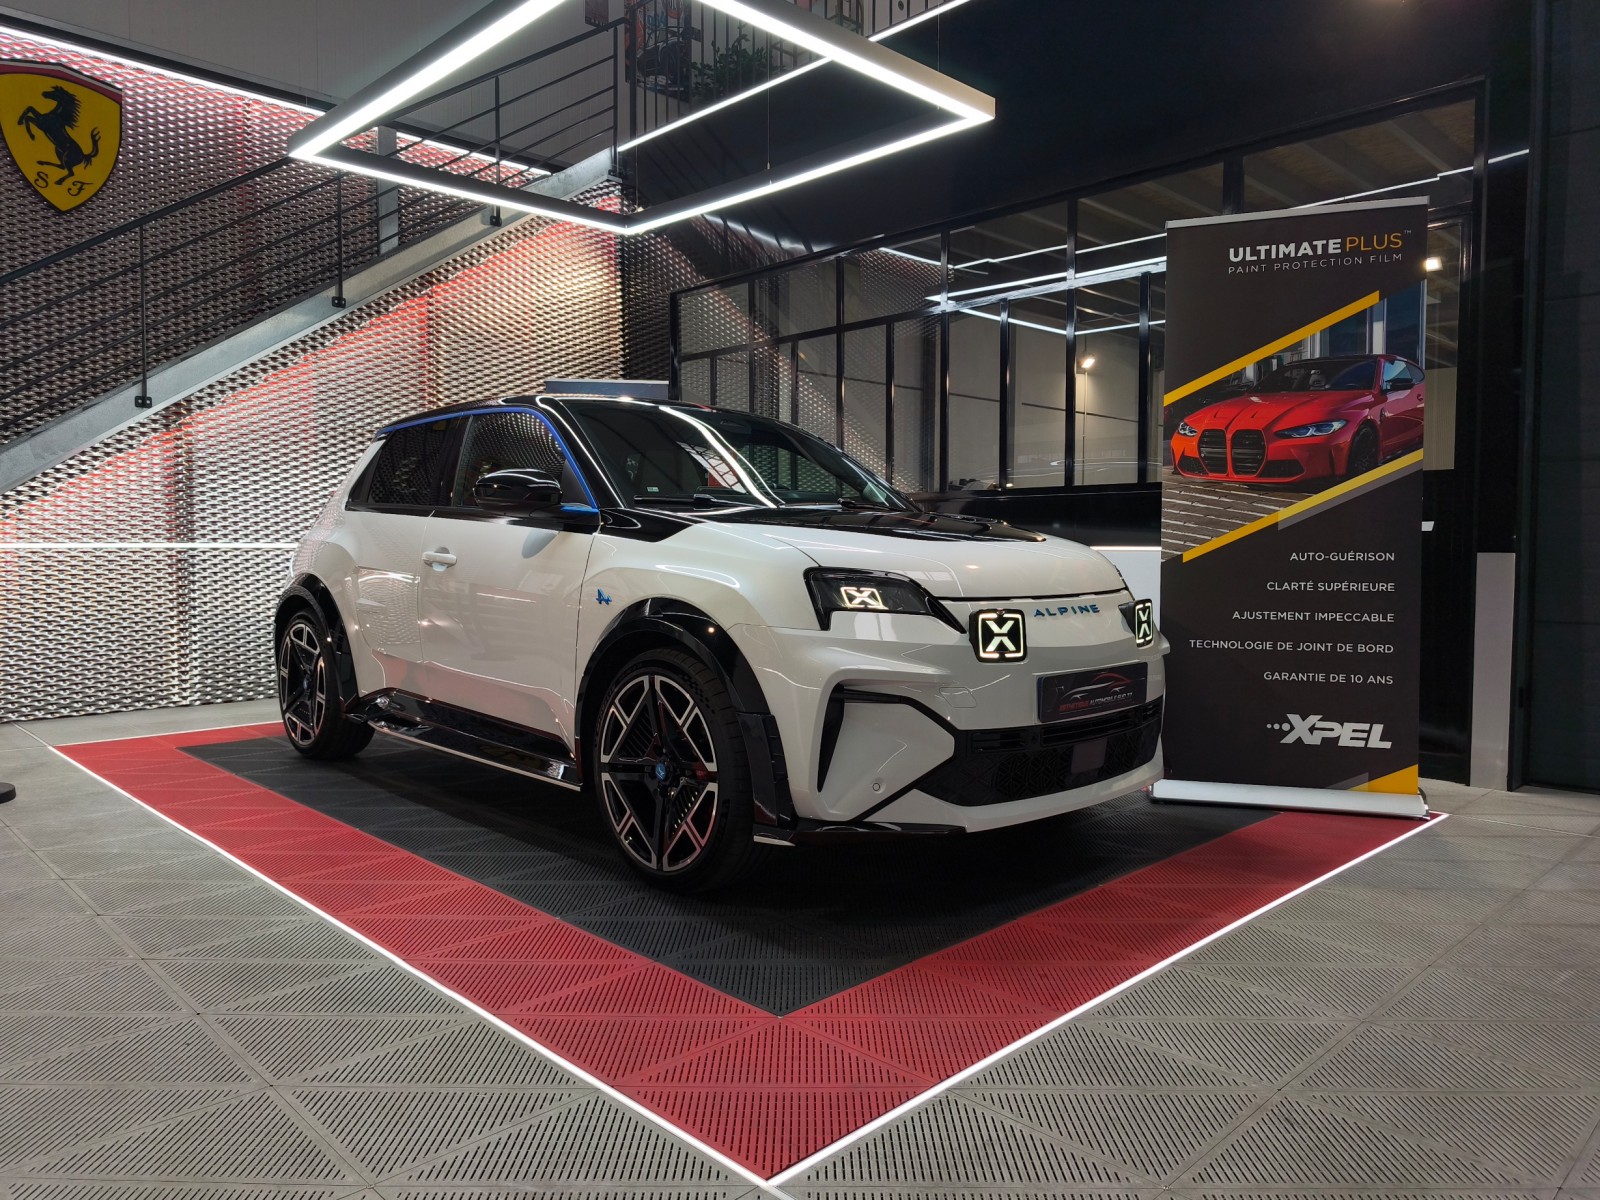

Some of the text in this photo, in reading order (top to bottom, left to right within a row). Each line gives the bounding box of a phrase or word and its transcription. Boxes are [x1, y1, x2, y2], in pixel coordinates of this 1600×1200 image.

[1229, 238, 1342, 262] ULTIMATE
[1228, 253, 1402, 275] PAINT PROTECTION FILM
[1290, 550, 1395, 562] AUTO-GUÉRISON
[1266, 580, 1395, 592] CLARTÉ SUPÉRIEURE
[1033, 604, 1101, 618] ALPINE
[1232, 610, 1395, 623] AJUSTEMENT IMPECCABLE
[1189, 639, 1394, 654] TECHNOLOGIE DE JOINT DE BORD
[1263, 671, 1394, 685] GARANTIE DE 10 ANS
[1279, 713, 1393, 749] XPEL
